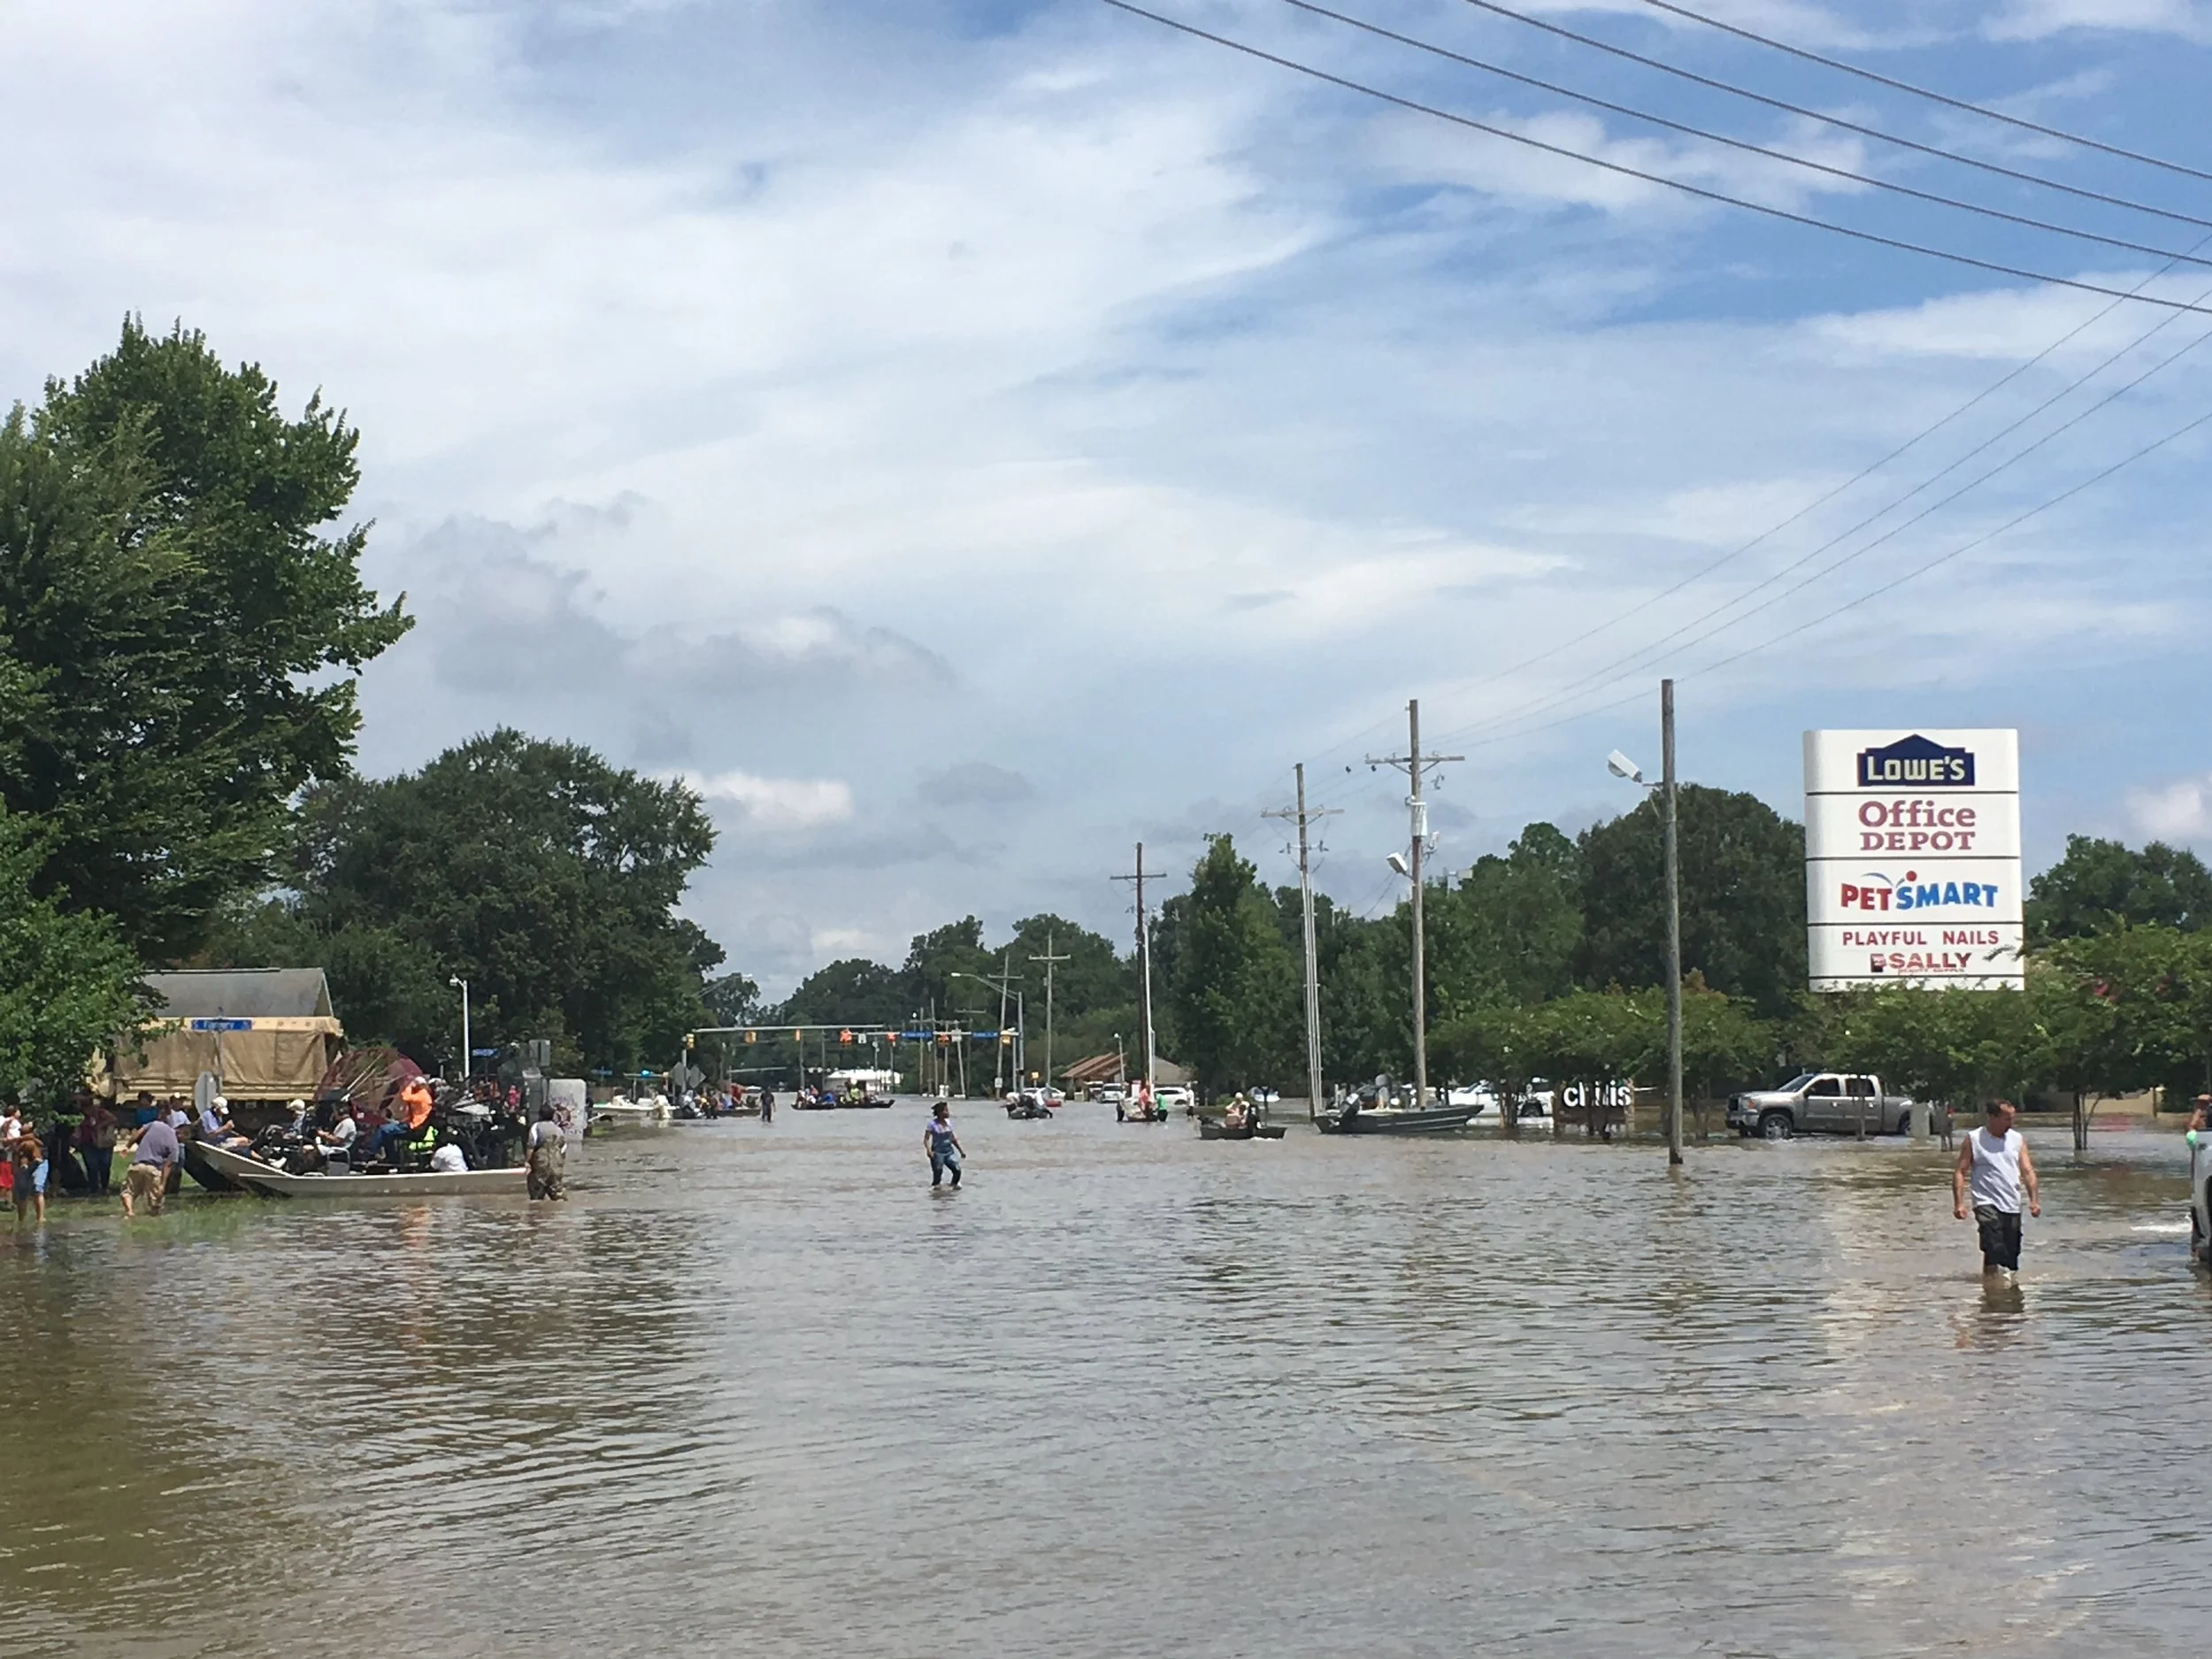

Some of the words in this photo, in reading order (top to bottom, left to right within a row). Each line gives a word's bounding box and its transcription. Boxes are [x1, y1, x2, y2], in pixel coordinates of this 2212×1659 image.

[1867, 755, 1965, 781] LOWE'S
[1858, 800, 1976, 827] Office
[1860, 831, 1976, 851] DEPOT
[1843, 931, 1927, 946] PLAYFUL
[1943, 930, 2000, 945] NAILS
[1887, 953, 1972, 969] SALLY
